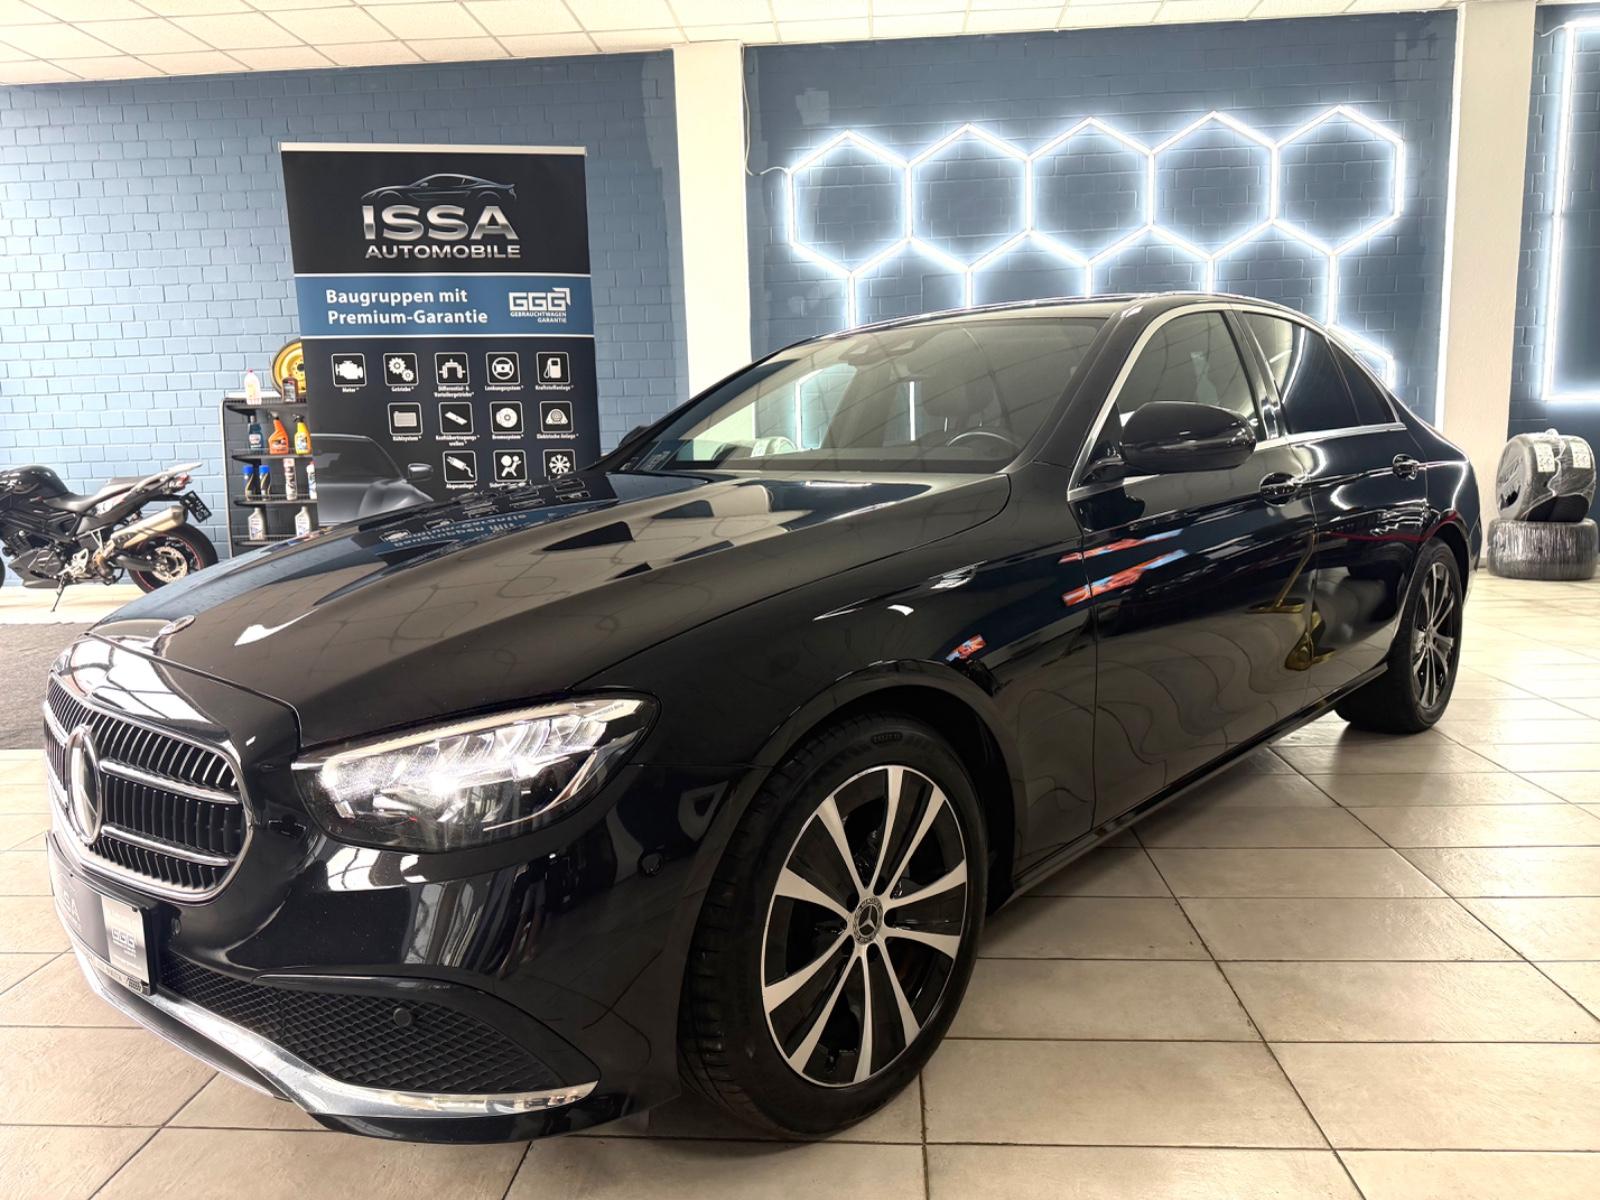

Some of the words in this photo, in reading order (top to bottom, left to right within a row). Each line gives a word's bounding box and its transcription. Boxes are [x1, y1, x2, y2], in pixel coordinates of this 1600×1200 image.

[362, 205, 519, 241] ISSA
[364, 244, 521, 259] AUTOMOBILE
[325, 289, 434, 307] Baugruppen
[439, 288, 467, 303] mit
[508, 291, 567, 311] GGG
[327, 308, 488, 325] Premium-Garantie
